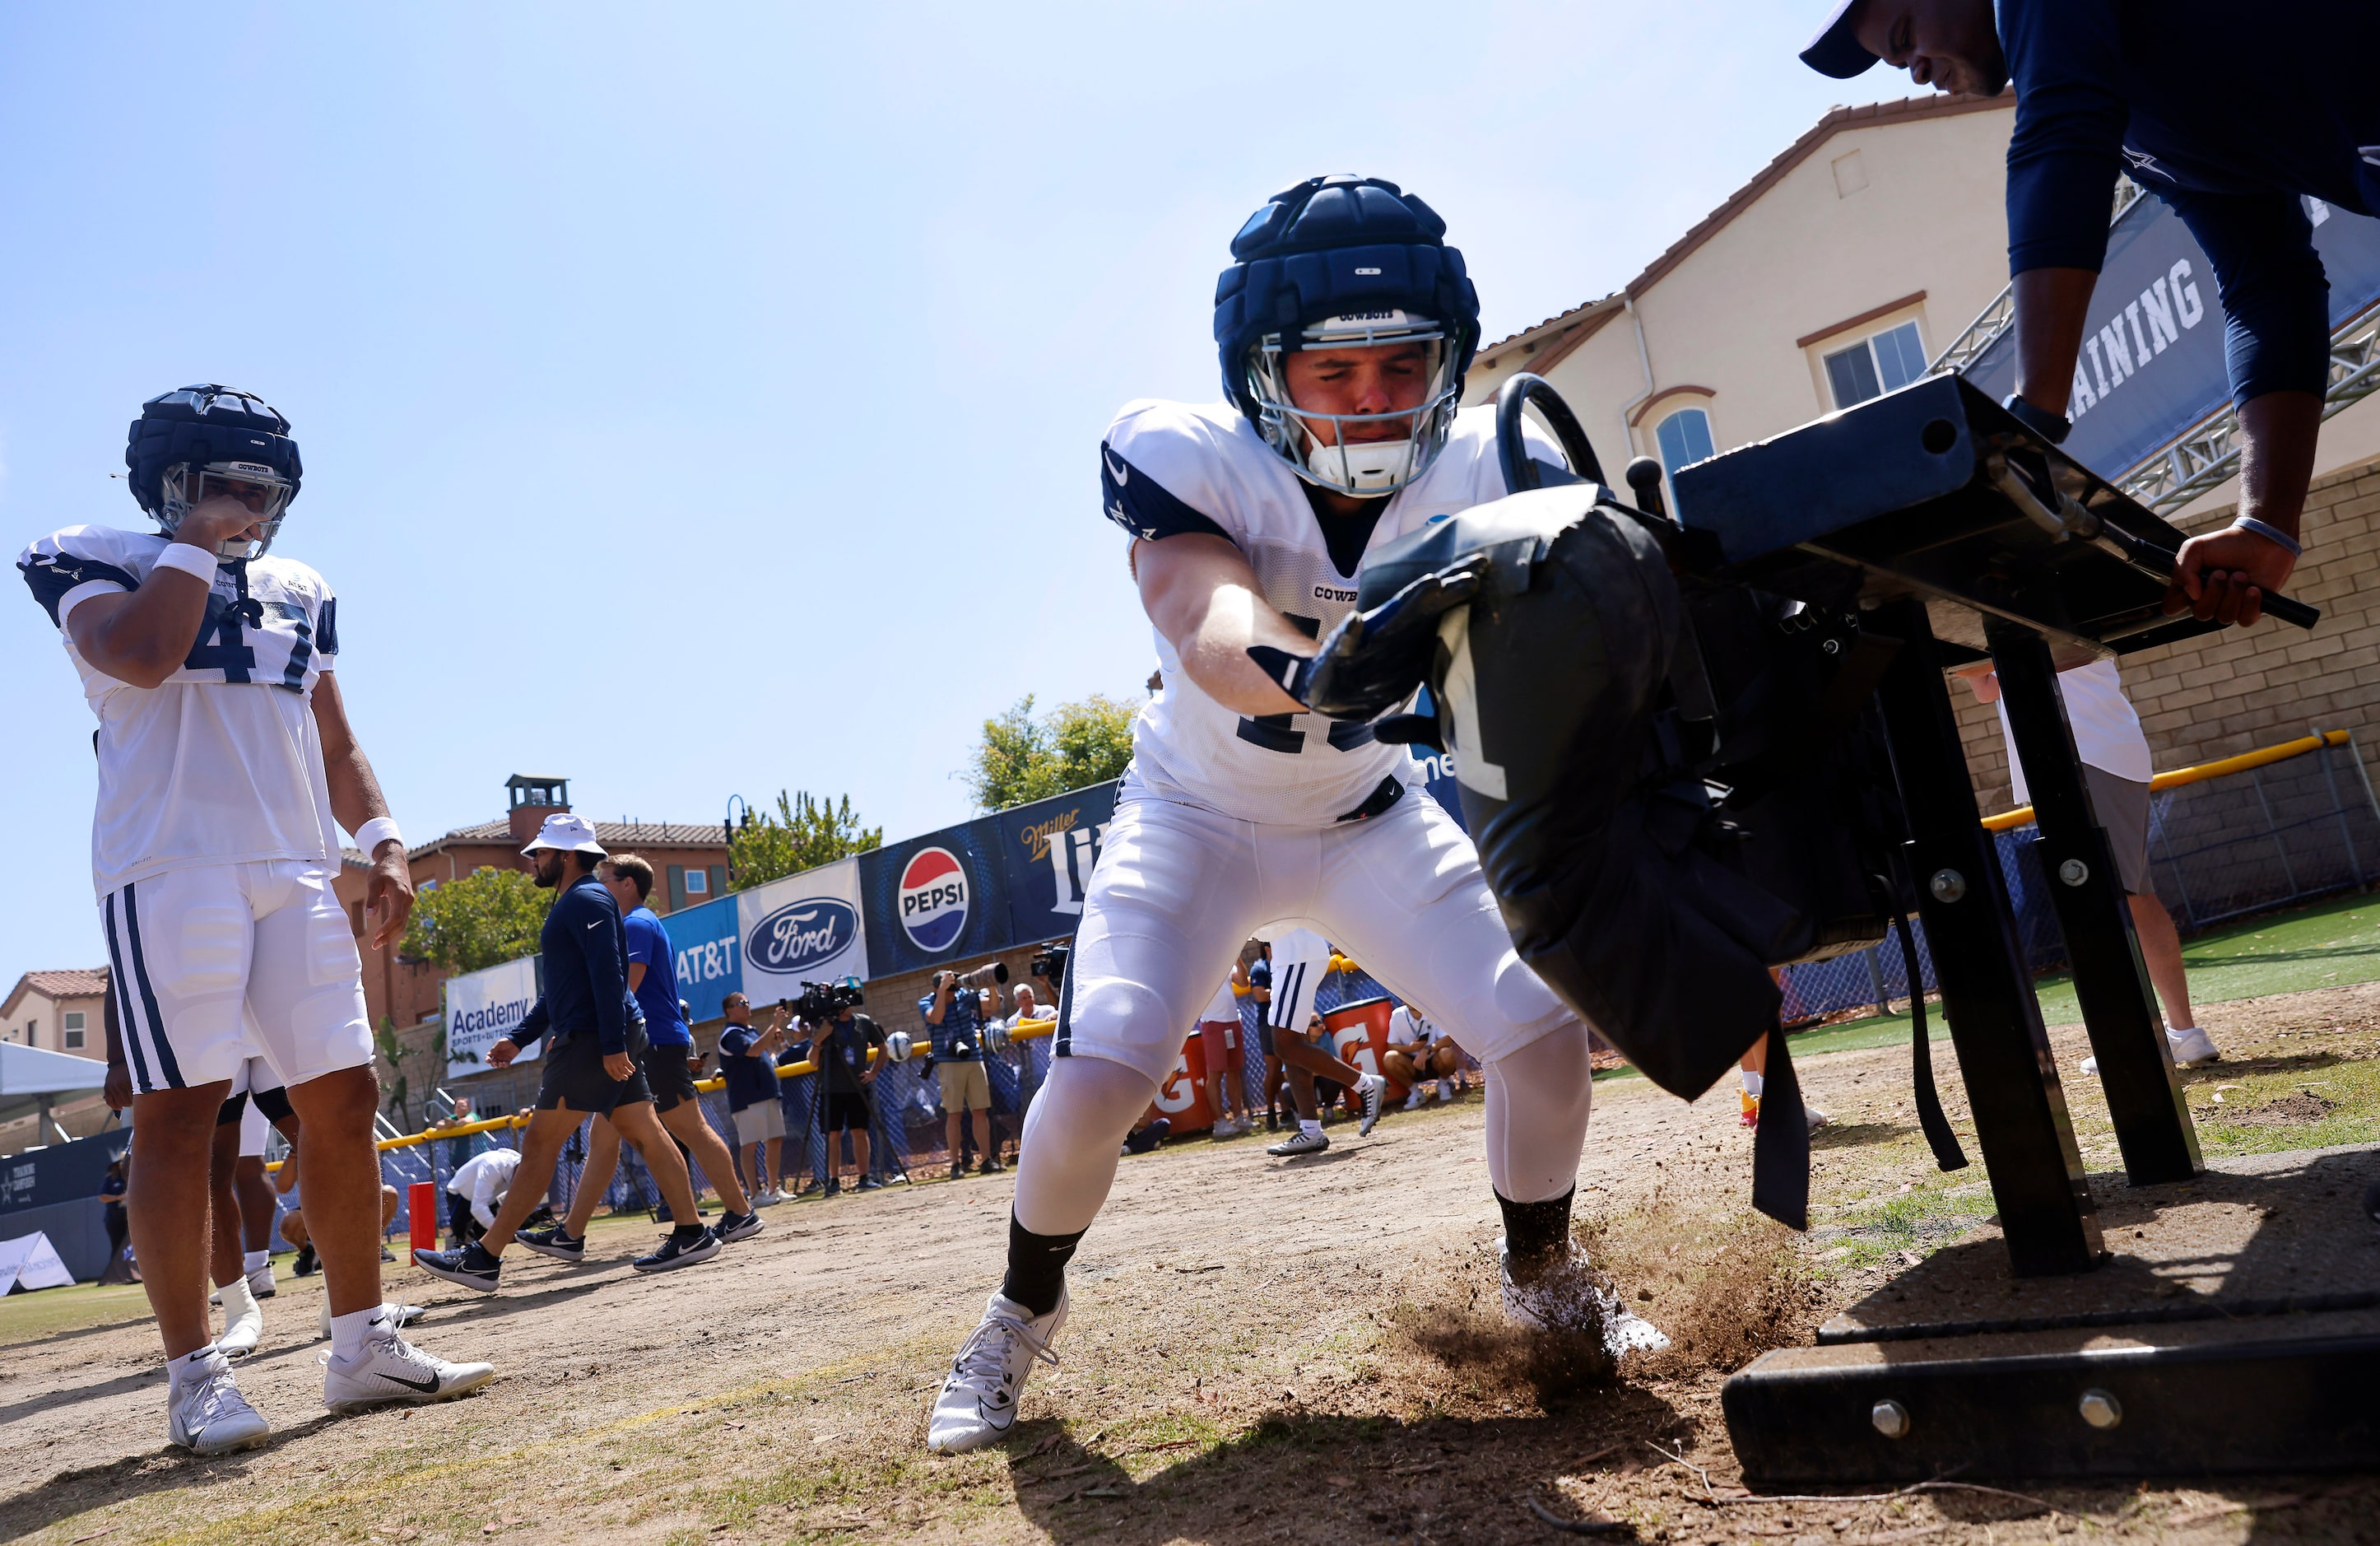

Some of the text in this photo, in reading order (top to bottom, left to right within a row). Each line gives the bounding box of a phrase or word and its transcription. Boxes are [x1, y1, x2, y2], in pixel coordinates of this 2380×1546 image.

[1340, 310, 1394, 322] COWBOYS
[2066, 258, 2205, 425] AINING
[238, 463, 269, 473] COWBOYS
[288, 580, 308, 592] AT&T
[1314, 586, 1359, 602] COWB
[184, 594, 312, 694] 47
[1415, 752, 1456, 783] me
[1020, 808, 1080, 863] Miller
[1042, 822, 1111, 915] Li
[904, 882, 964, 916] PEPSI
[767, 910, 836, 964] Ford
[676, 935, 737, 985] AT&T
[452, 998, 528, 1036] Academy
